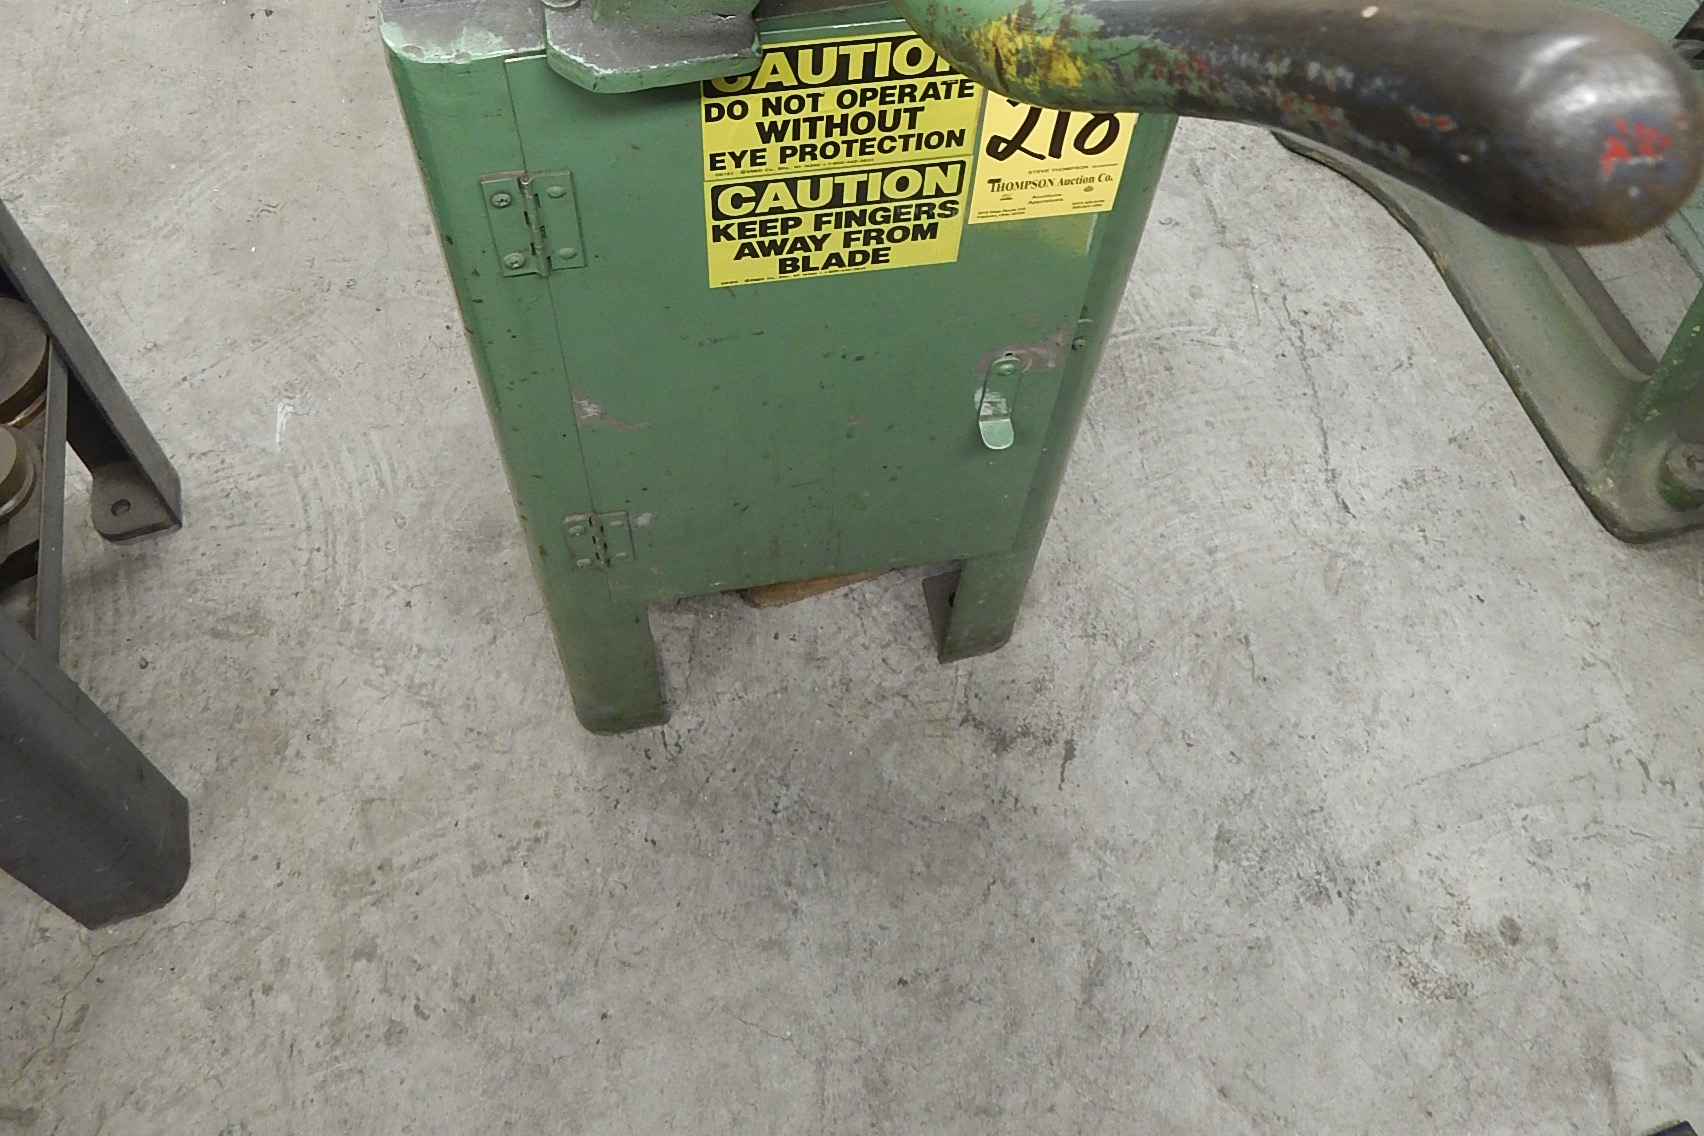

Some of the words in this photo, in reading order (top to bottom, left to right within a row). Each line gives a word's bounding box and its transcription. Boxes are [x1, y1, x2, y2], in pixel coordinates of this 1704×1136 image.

[704, 99, 749, 123] DO
[761, 91, 825, 117] NOT
[836, 78, 975, 110] OPERATE
[755, 106, 925, 145] WITHOUT
[709, 148, 767, 172] EYE
[779, 129, 966, 164] PROTECTION
[717, 163, 961, 217] CAUTION
[987, 177, 1056, 193] THOMPSON
[1055, 174, 1095, 187] Auction
[1097, 172, 1113, 183] Co.
[712, 216, 803, 243] KEEP
[813, 199, 960, 231] FINGERS
[733, 233, 832, 261] AWAY
[842, 222, 939, 249] FROM
[778, 246, 892, 275] BLADE
